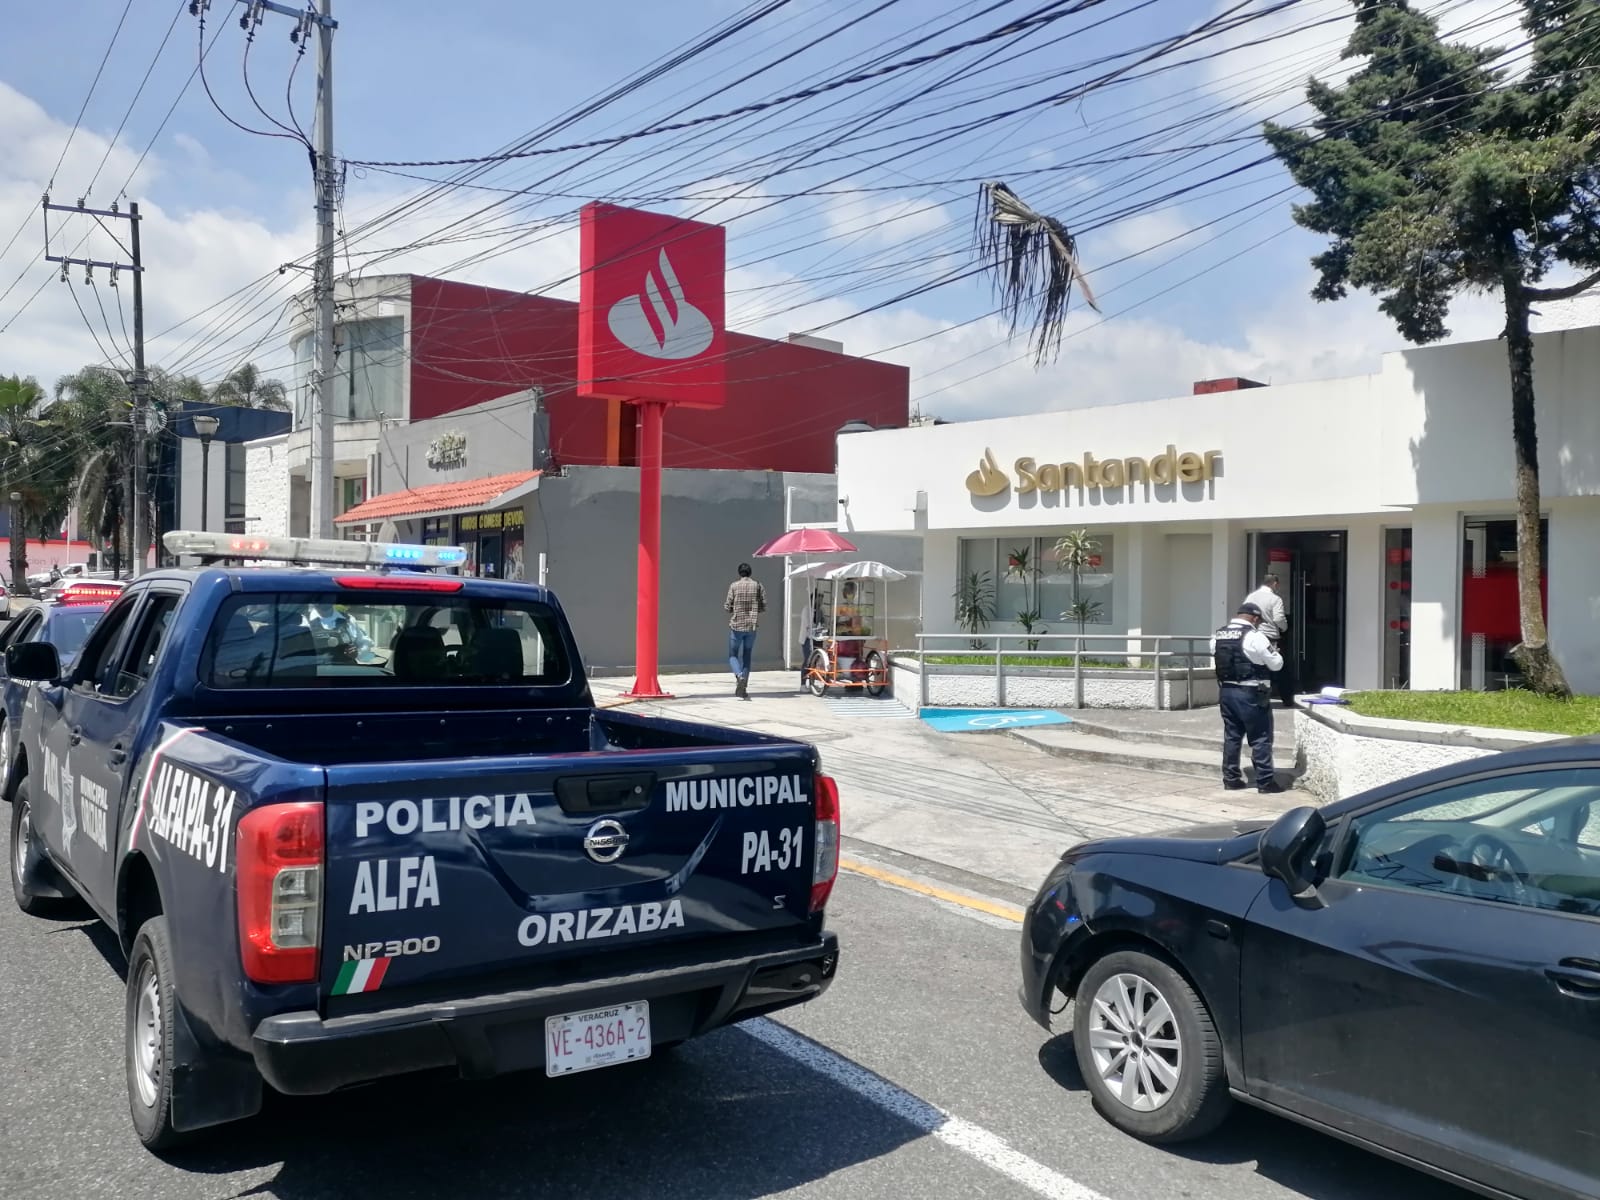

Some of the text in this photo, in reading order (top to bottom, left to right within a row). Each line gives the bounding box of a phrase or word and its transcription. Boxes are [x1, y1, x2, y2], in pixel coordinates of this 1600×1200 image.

[1015, 444, 1223, 495] Santander
[356, 775, 807, 838] POLICIA MUNICIPAL
[741, 826, 803, 874] PA-31
[349, 855, 440, 915] ALFA
[517, 900, 684, 947] ORIZABA
[343, 935, 441, 961] NP300
[552, 1017, 646, 1057] VE-436A-2
[578, 1009, 620, 1022] VERACRUZ
